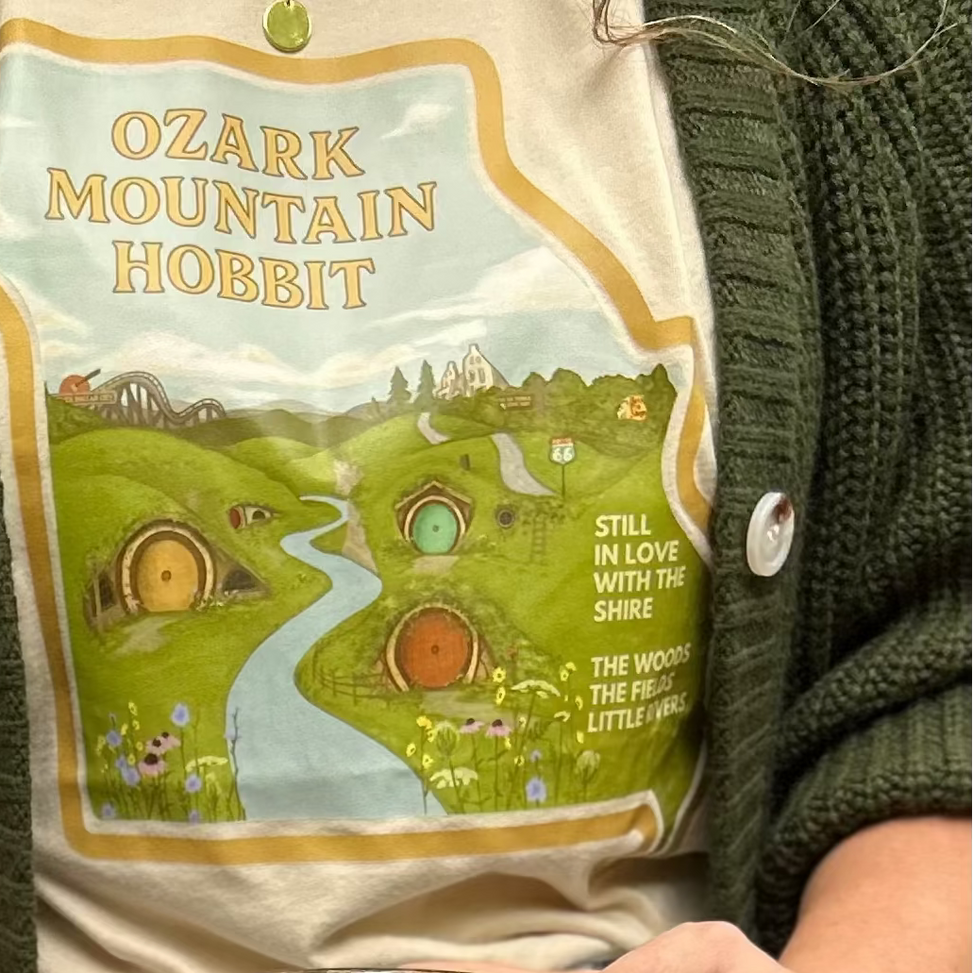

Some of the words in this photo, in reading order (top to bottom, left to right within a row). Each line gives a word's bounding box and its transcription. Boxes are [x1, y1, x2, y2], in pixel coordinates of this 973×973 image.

[111, 108, 366, 180] OZARK
[44, 167, 438, 245] MOUNTAIN
[112, 240, 376, 310] HOBBIT
[552, 447, 574, 460] 66
[595, 514, 651, 537] STILL
[594, 544, 617, 566] IN
[625, 540, 679, 565] LOVE
[594, 570, 651, 593] WITH
[656, 566, 686, 590] THE
[594, 598, 653, 622] SHIRE
[591, 656, 628, 678] THE
[634, 642, 691, 675] WOODS
[590, 683, 626, 705] THE
[588, 707, 644, 733] LITTLE
